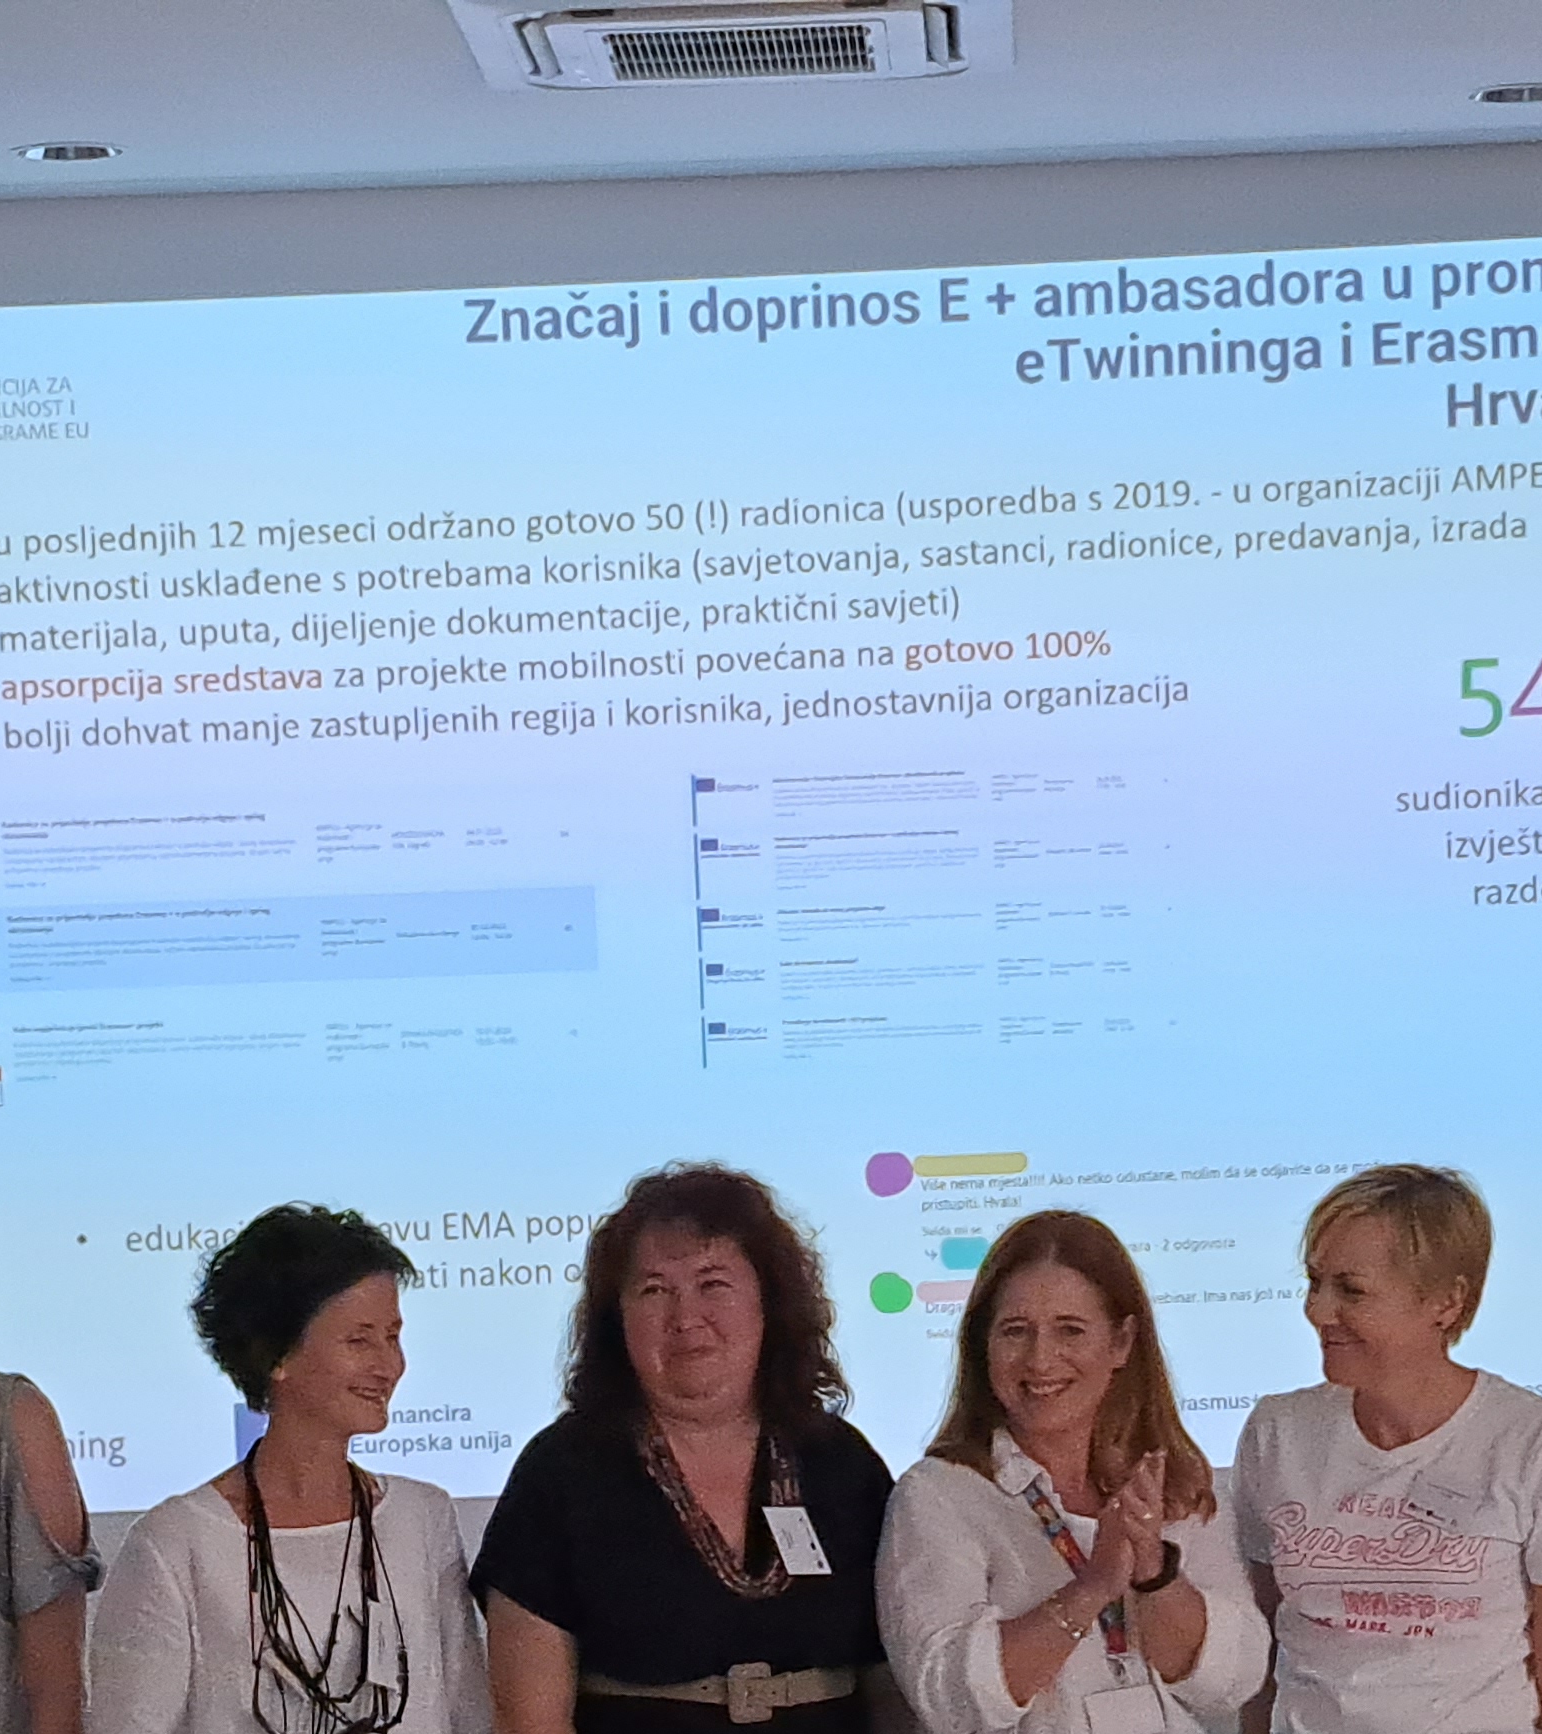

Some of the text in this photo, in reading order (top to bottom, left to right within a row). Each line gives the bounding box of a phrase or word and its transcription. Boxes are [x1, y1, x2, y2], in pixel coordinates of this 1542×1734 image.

[465, 292, 641, 350] Značaj
[660, 291, 671, 337] i
[690, 284, 922, 345] doprinos
[940, 279, 971, 324] E
[987, 283, 1017, 317] +
[1035, 261, 1365, 319] ambasadora
[1384, 266, 1413, 301] u
[1016, 328, 1323, 386] eTwinninga
[1342, 322, 1353, 369] i
[47, 377, 74, 396] ZA
[70, 400, 76, 414] I
[65, 422, 90, 440] EU
[25, 522, 197, 562] posljednjih
[210, 520, 246, 549] 12
[259, 516, 377, 553] mjeseci
[388, 512, 517, 543] održano
[527, 511, 637, 544] gotovo
[647, 504, 686, 532] 50
[696, 500, 730, 537] (!)
[742, 496, 886, 528] radionica
[898, 486, 1077, 528] (usporedba
[1089, 491, 1103, 512] s
[1114, 480, 1201, 511] 2019.
[1234, 485, 1252, 505] u
[1263, 468, 1441, 509] organizaciji
[162, 568, 322, 600] usklađene
[334, 571, 347, 593] s
[358, 561, 532, 599] potrebama
[544, 552, 682, 585] korisnika
[694, 543, 910, 585] (savjetovanja,
[922, 536, 1056, 569] sastanci,
[1068, 528, 1223, 562] radionice,
[1236, 518, 1421, 560] predavanja,
[1433, 512, 1528, 544] izrada
[0, 585, 961, 656] materijala, uputa, dijeljenje dokumentacije, praktični savjeti)
[2, 630, 1113, 707] apsorpcija sredstava za projekte mobilnosti povećana na gotovo 100%
[5, 676, 1190, 755] bolji dohvat manje zastupljenih regija i korisnika, jednostavnija organizacija
[1223, 1166, 1241, 1179] da
[441, 1210, 516, 1242] EMA
[459, 1257, 553, 1288] nakon
[391, 1403, 472, 1424] nancira
[349, 1430, 512, 1457] Europska unija
